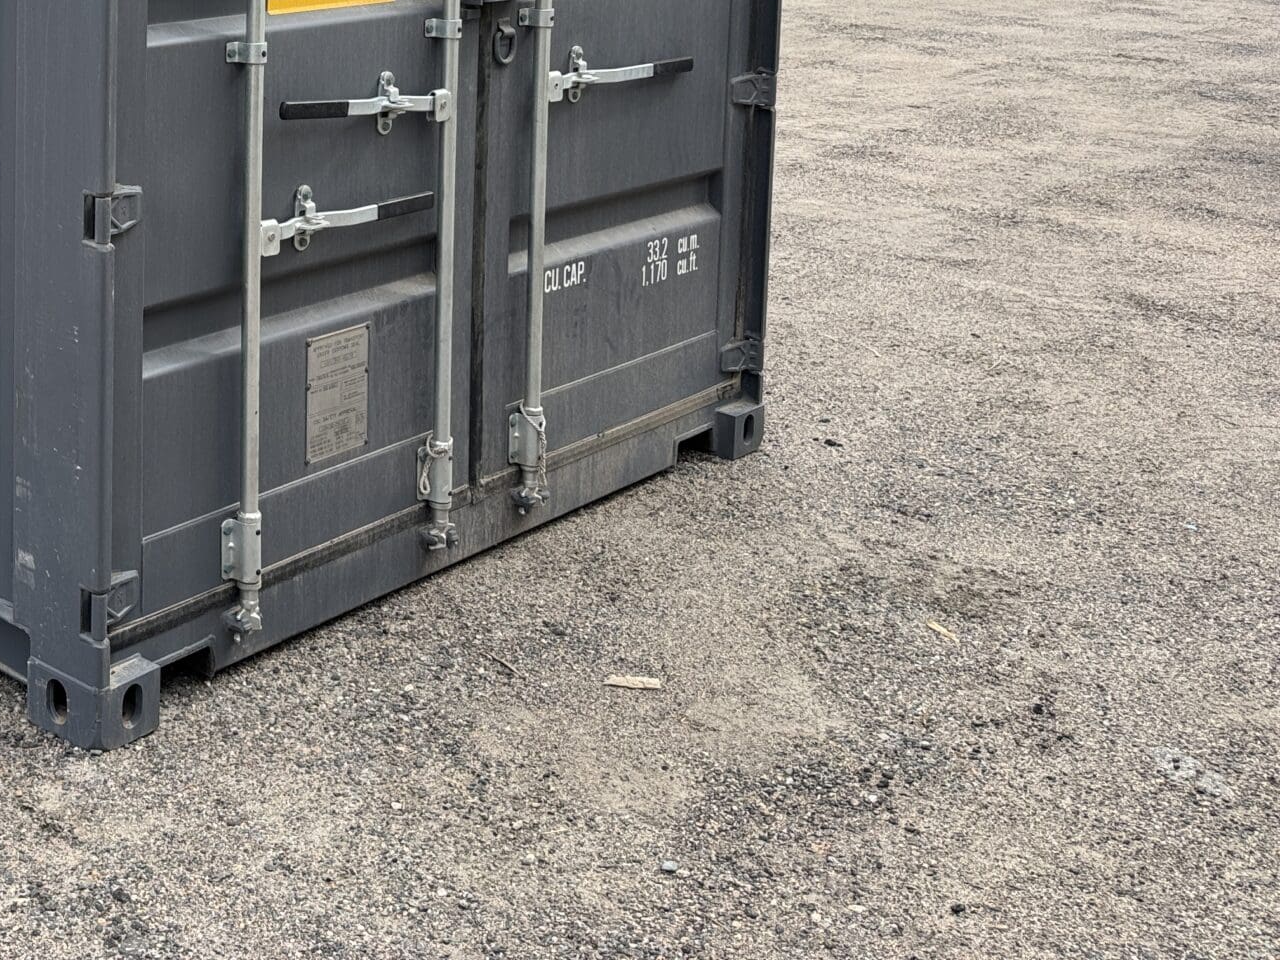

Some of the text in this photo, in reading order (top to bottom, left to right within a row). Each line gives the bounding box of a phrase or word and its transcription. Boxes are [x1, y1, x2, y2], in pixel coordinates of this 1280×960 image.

[544, 270, 561, 293] CU.
[563, 261, 587, 287] CAP.
[647, 237, 668, 263] 33.2
